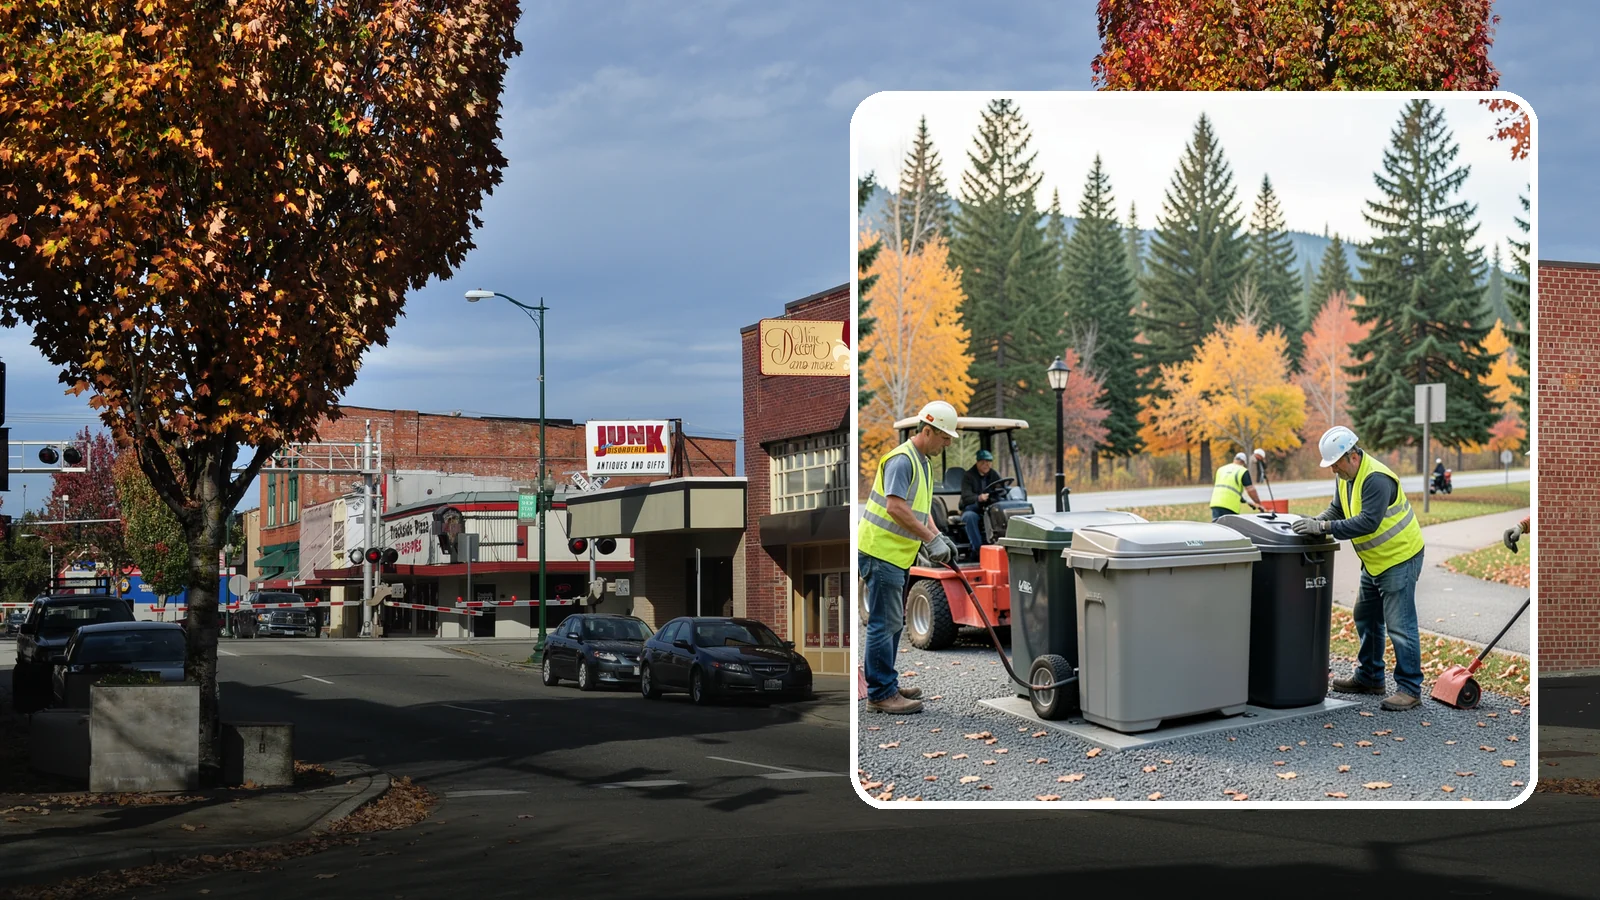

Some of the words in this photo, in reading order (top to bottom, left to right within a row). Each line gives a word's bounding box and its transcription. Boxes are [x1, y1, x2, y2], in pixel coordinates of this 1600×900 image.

[596, 425, 665, 457] JUNK
[608, 446, 646, 454] DISORDERLY
[597, 461, 628, 470] ANTIQUES
[631, 461, 644, 469] AND
[647, 460, 665, 469] GIFTS
[352, 498, 364, 511] CRO
[390, 521, 413, 539] Trackside
[414, 519, 429, 535] Pizza
